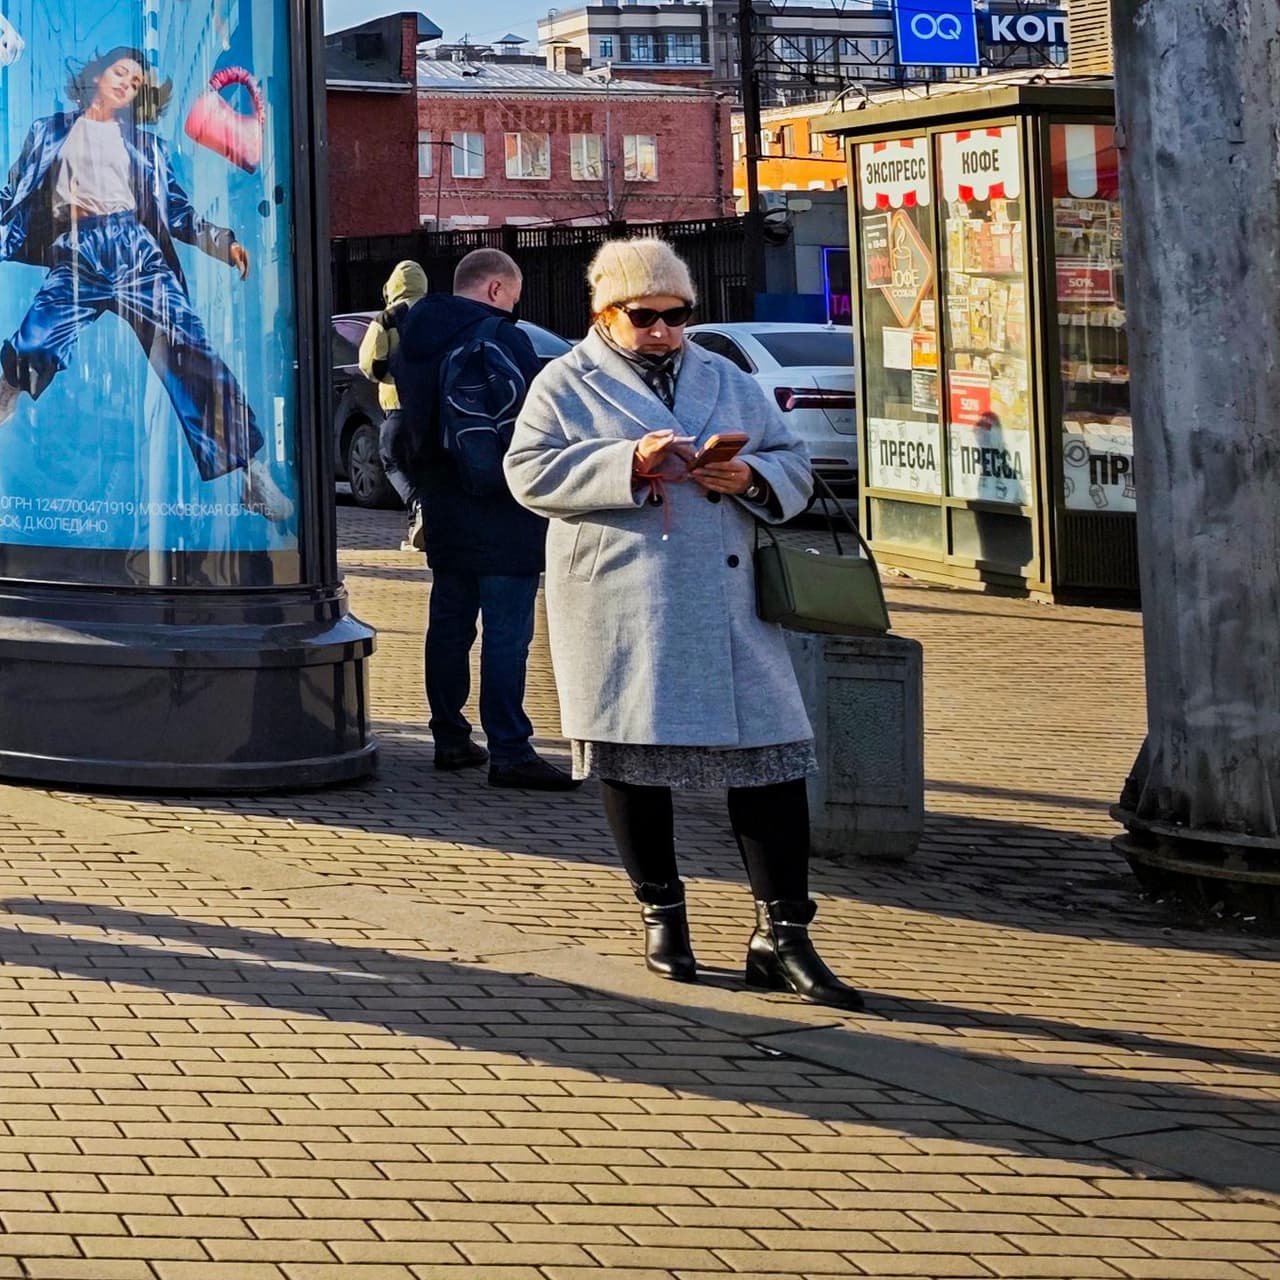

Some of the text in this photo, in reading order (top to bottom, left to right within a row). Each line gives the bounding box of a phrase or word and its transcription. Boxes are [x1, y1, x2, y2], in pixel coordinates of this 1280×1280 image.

[991, 15, 1068, 43] КОП
[866, 157, 927, 185] ЭКСПРЕСС
[961, 148, 1000, 175] КОФЕ
[879, 439, 937, 471] ПРЕССА
[960, 446, 1024, 481] ПРЕССА
[1089, 455, 1136, 486] ПР
[0, 495, 33, 511] ОГРН
[139, 502, 223, 517] МОСКОВСКАЯ
